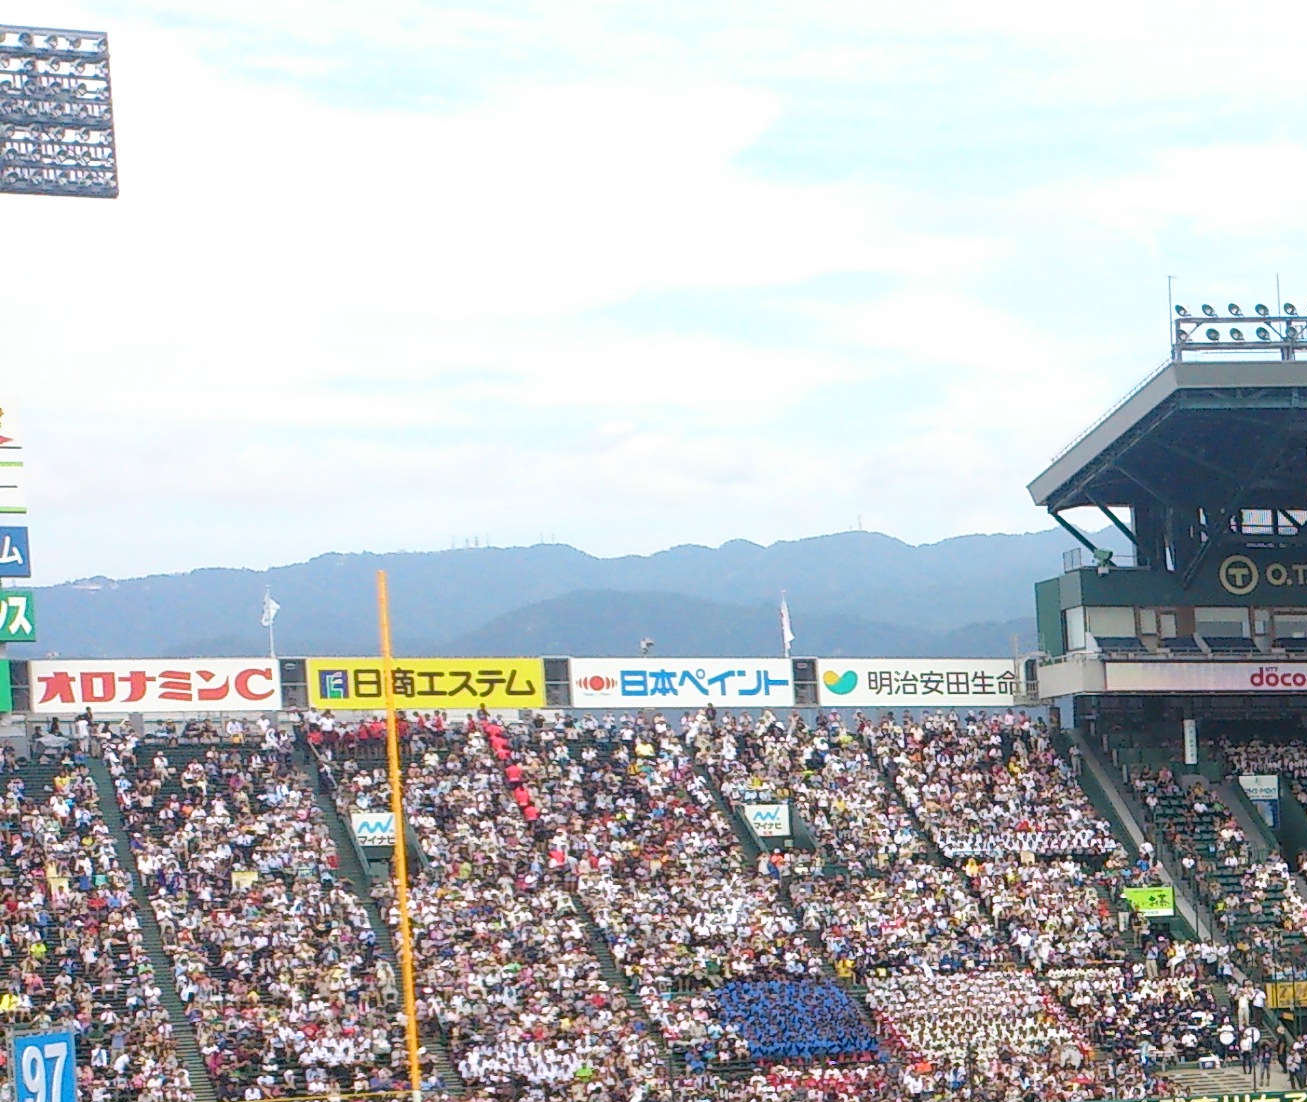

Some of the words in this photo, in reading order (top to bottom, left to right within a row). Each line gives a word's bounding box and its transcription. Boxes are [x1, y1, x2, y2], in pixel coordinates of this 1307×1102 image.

[37, 668, 275, 703] オロナミンC
[353, 667, 535, 700] 日商エステム
[620, 669, 789, 697] 日本ペイント
[868, 669, 1020, 697] 明治安田生命
